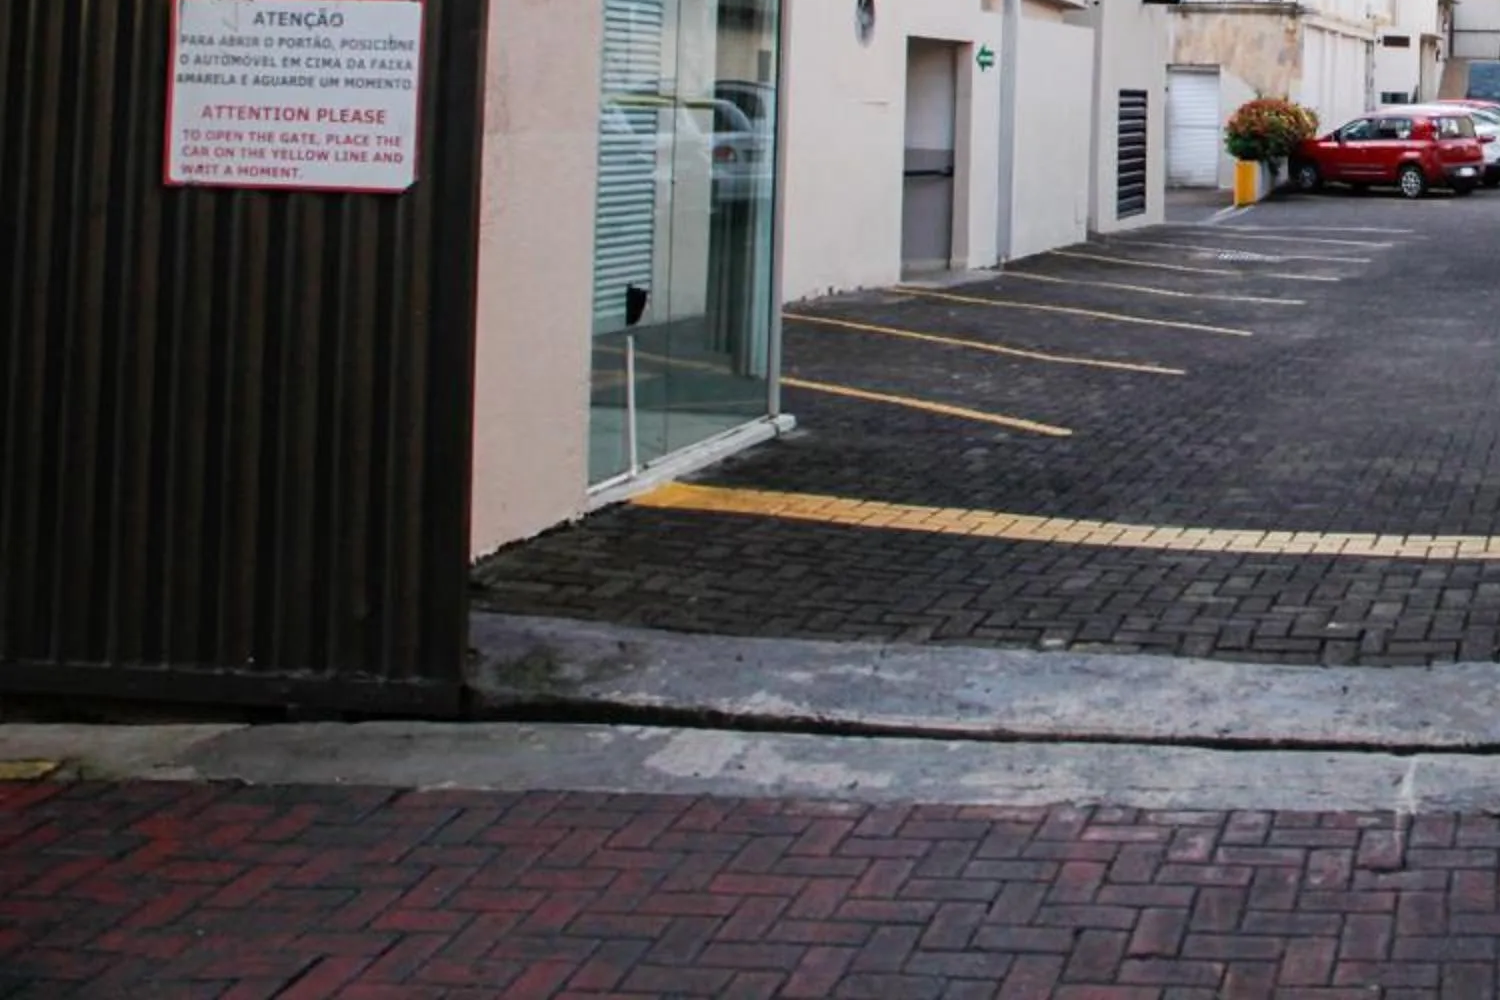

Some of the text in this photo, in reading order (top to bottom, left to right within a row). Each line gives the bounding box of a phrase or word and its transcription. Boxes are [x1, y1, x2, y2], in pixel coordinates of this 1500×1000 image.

[253, 8, 344, 31] ATENÇÃO
[180, 35, 215, 46] PARA
[219, 36, 259, 48] ABRIR
[263, 37, 274, 48] O
[340, 38, 415, 51] POSICIONE
[180, 54, 189, 66] O
[282, 57, 301, 68] EM
[304, 57, 341, 69] CIMA
[346, 58, 365, 70] DA
[370, 58, 413, 71] FAIXA
[176, 73, 412, 90] AMARELA E AGUARDE UM MOMENTO
[201, 105, 387, 125] ATTENTION PLEASE
[182, 129, 200, 141] TO
[205, 130, 243, 142] OPEN
[247, 131, 275, 144] THE
[325, 133, 369, 146] PLACE
[376, 134, 403, 147] THE
[182, 145, 403, 163] CAR ON THE YELLOW LINE AND
[180, 163, 218, 176] WAIT
[223, 164, 233, 176] A
